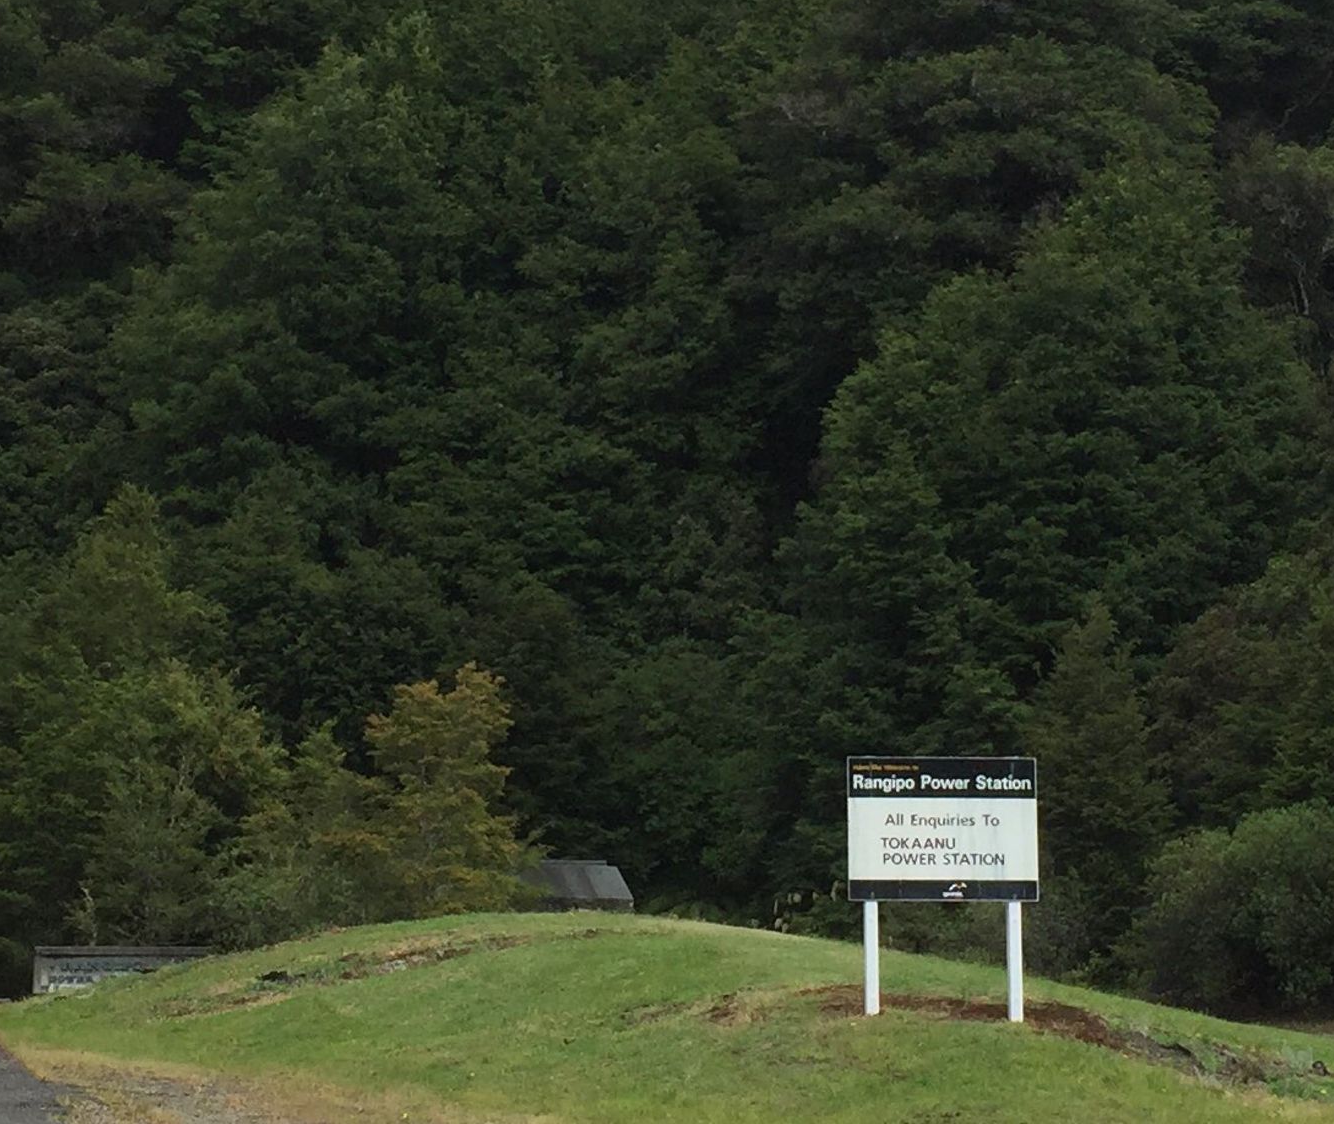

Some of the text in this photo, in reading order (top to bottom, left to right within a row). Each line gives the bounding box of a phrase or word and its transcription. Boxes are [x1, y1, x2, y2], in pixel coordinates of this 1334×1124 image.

[852, 773, 1032, 793] Rangipo Power Station
[884, 813, 1000, 829] All Enquiries To
[880, 837, 956, 850] TOKAANU
[883, 852, 1005, 866] POWER STATION
